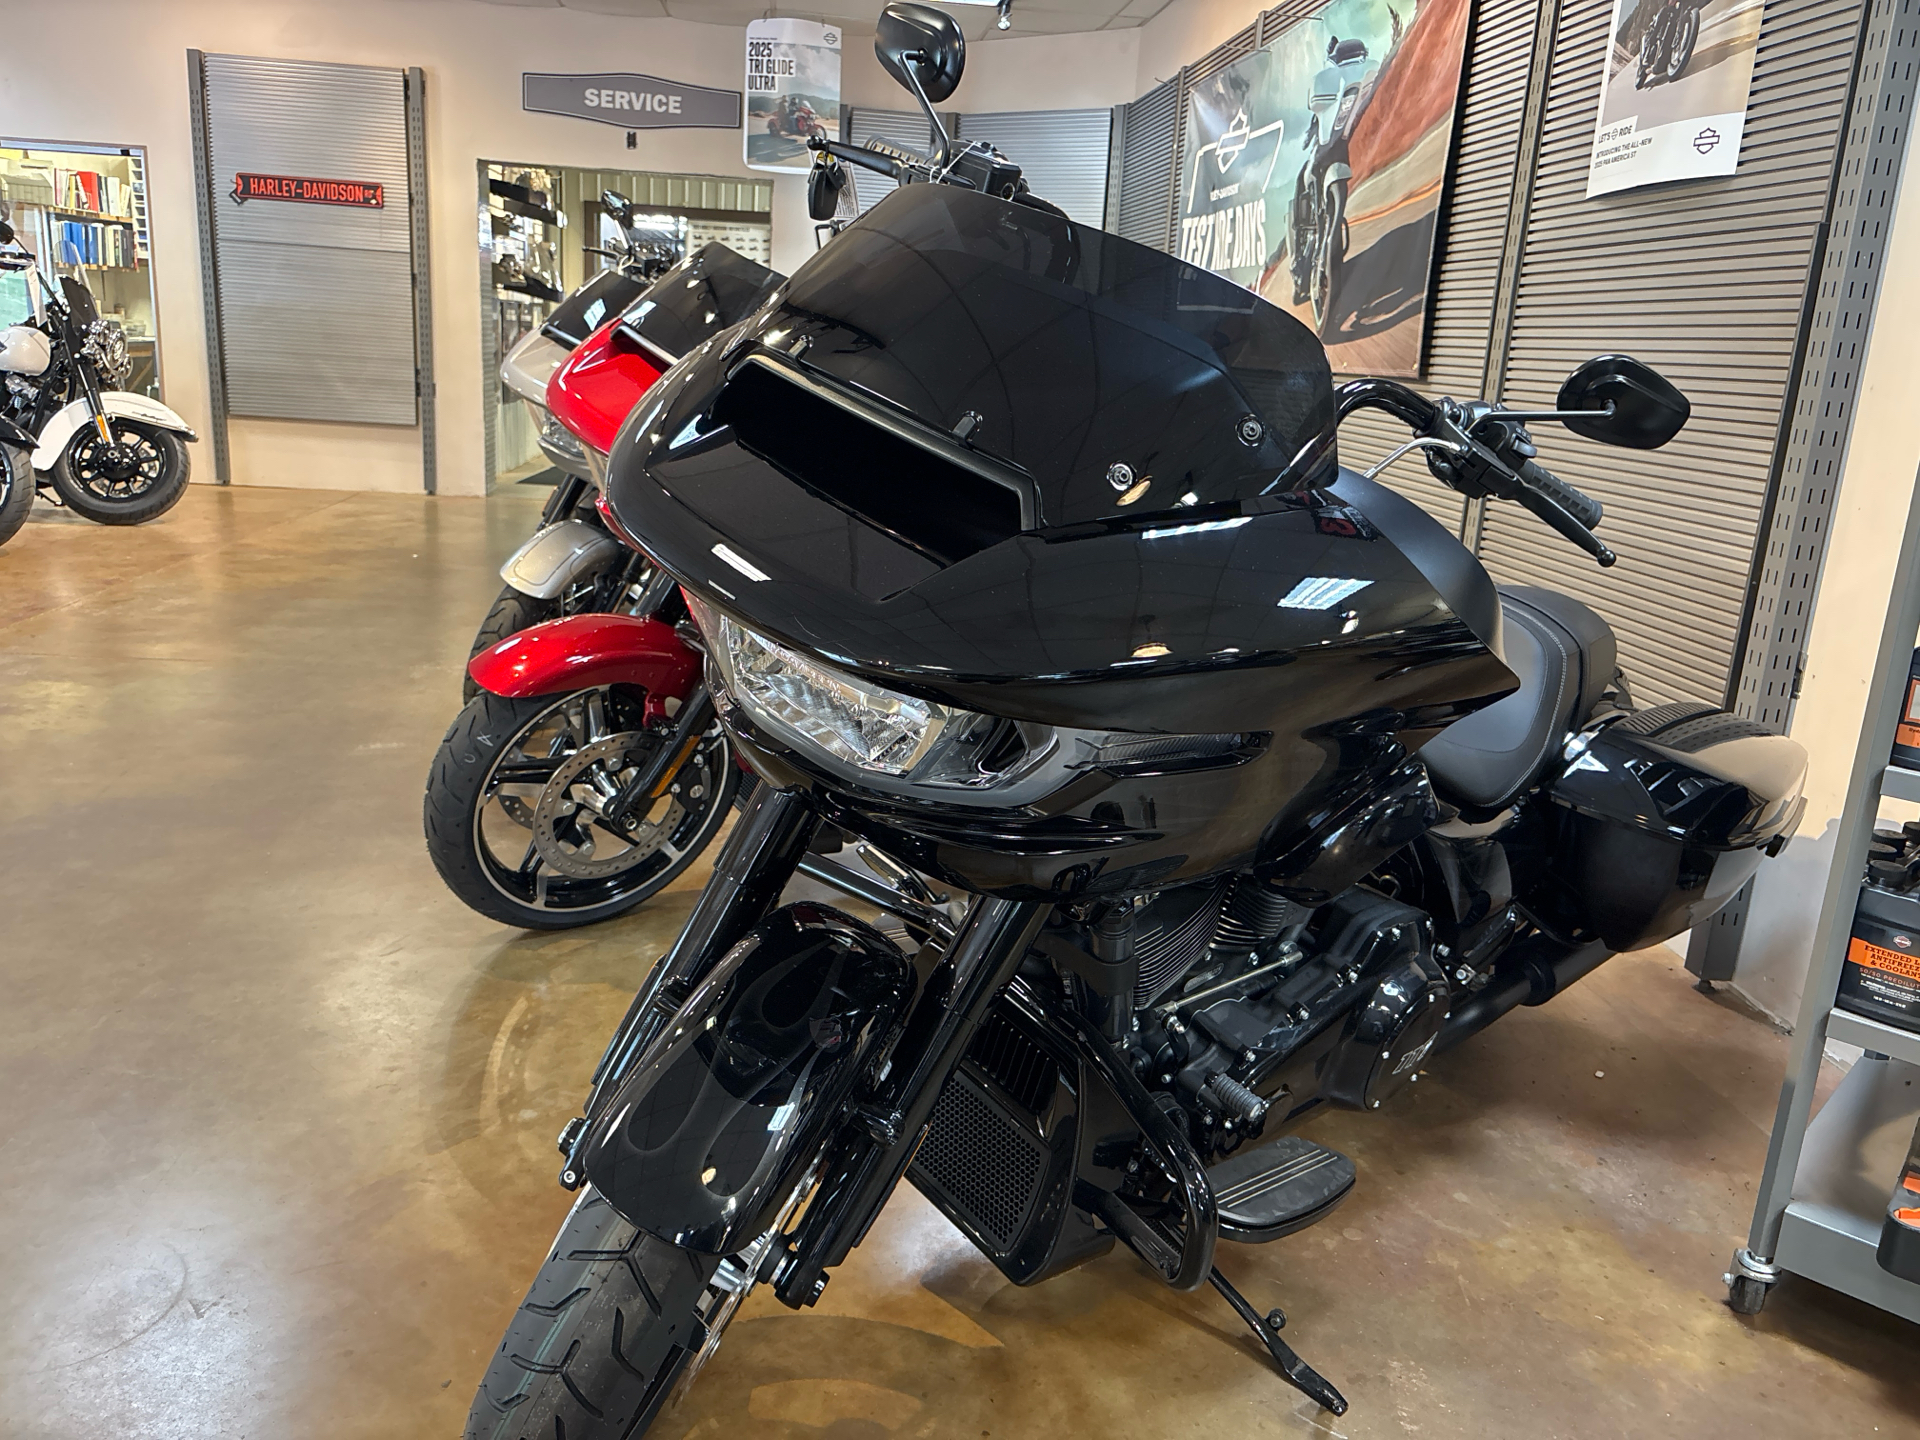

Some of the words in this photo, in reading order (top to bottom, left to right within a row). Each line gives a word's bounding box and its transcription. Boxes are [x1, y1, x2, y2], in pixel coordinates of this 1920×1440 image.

[749, 42, 772, 57] 2025
[748, 59, 764, 74] TRI
[766, 59, 794, 75] GLIDE
[748, 75, 776, 91] ULTRA
[584, 88, 682, 114] SERVICE
[1619, 125, 1632, 137] RIDE
[1631, 136, 1653, 148] ALL-NEW
[249, 177, 364, 203] HARLEY-DAVIDSON
[1180, 213, 1216, 269] TEST
[1232, 198, 1266, 269] DAYS
[1864, 944, 1912, 964] EXTENDED
[1870, 959, 1877, 967] &
[1859, 967, 1881, 977] 50/50
